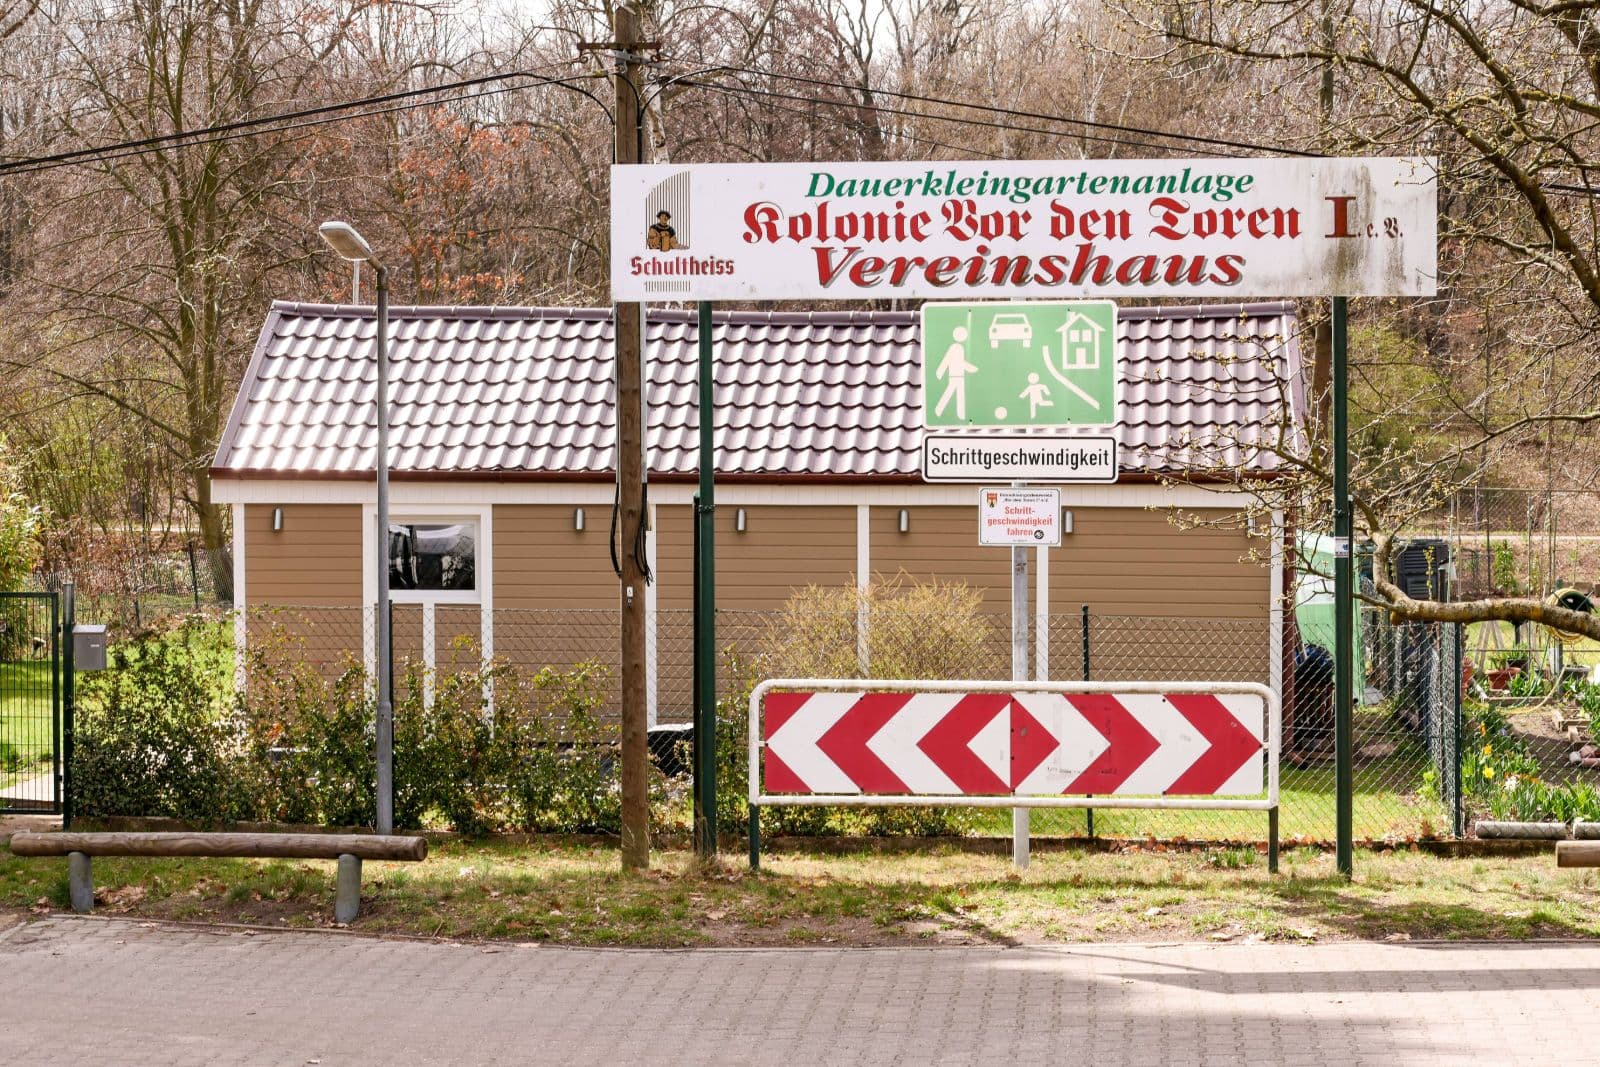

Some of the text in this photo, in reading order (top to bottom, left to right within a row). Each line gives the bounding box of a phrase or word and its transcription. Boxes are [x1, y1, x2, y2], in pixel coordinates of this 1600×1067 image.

[805, 168, 1255, 203] Dauerkleingartenanlage
[742, 200, 932, 244] Kolonie
[941, 199, 1032, 242] Vor
[1049, 199, 1134, 241] den
[1149, 197, 1302, 241] Toren
[630, 255, 735, 276] Schultheiss
[811, 242, 1246, 288] Vereinshaus
[931, 447, 1110, 470] Schrittgeschwindigkeit
[987, 516, 1053, 527] geschwindigkeit
[1004, 506, 1036, 516] Schritt-
[1007, 527, 1034, 537] fahren
